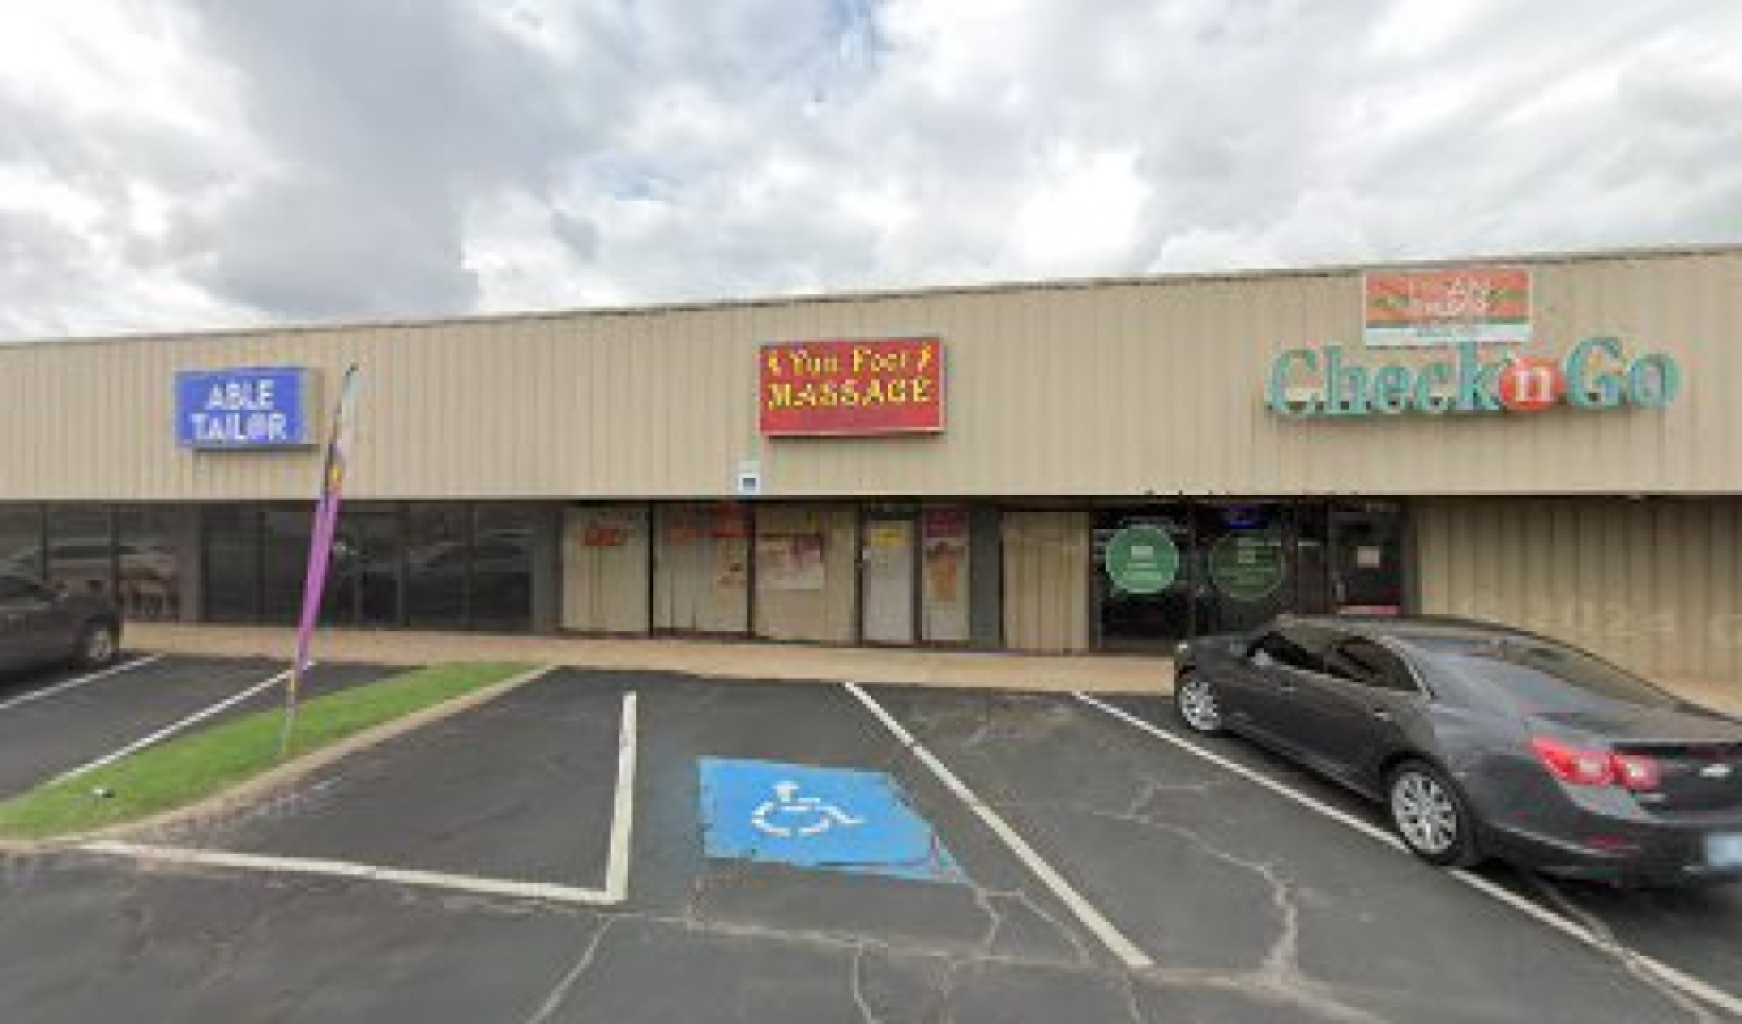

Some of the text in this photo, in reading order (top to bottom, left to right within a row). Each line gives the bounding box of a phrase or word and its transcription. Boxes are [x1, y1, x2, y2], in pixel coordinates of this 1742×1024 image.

[1269, 343, 1503, 415] Check
[1566, 337, 1681, 409] Go
[205, 378, 274, 410] ABLE
[768, 377, 932, 409] MASSAGE
[190, 412, 286, 441] TAILOR
